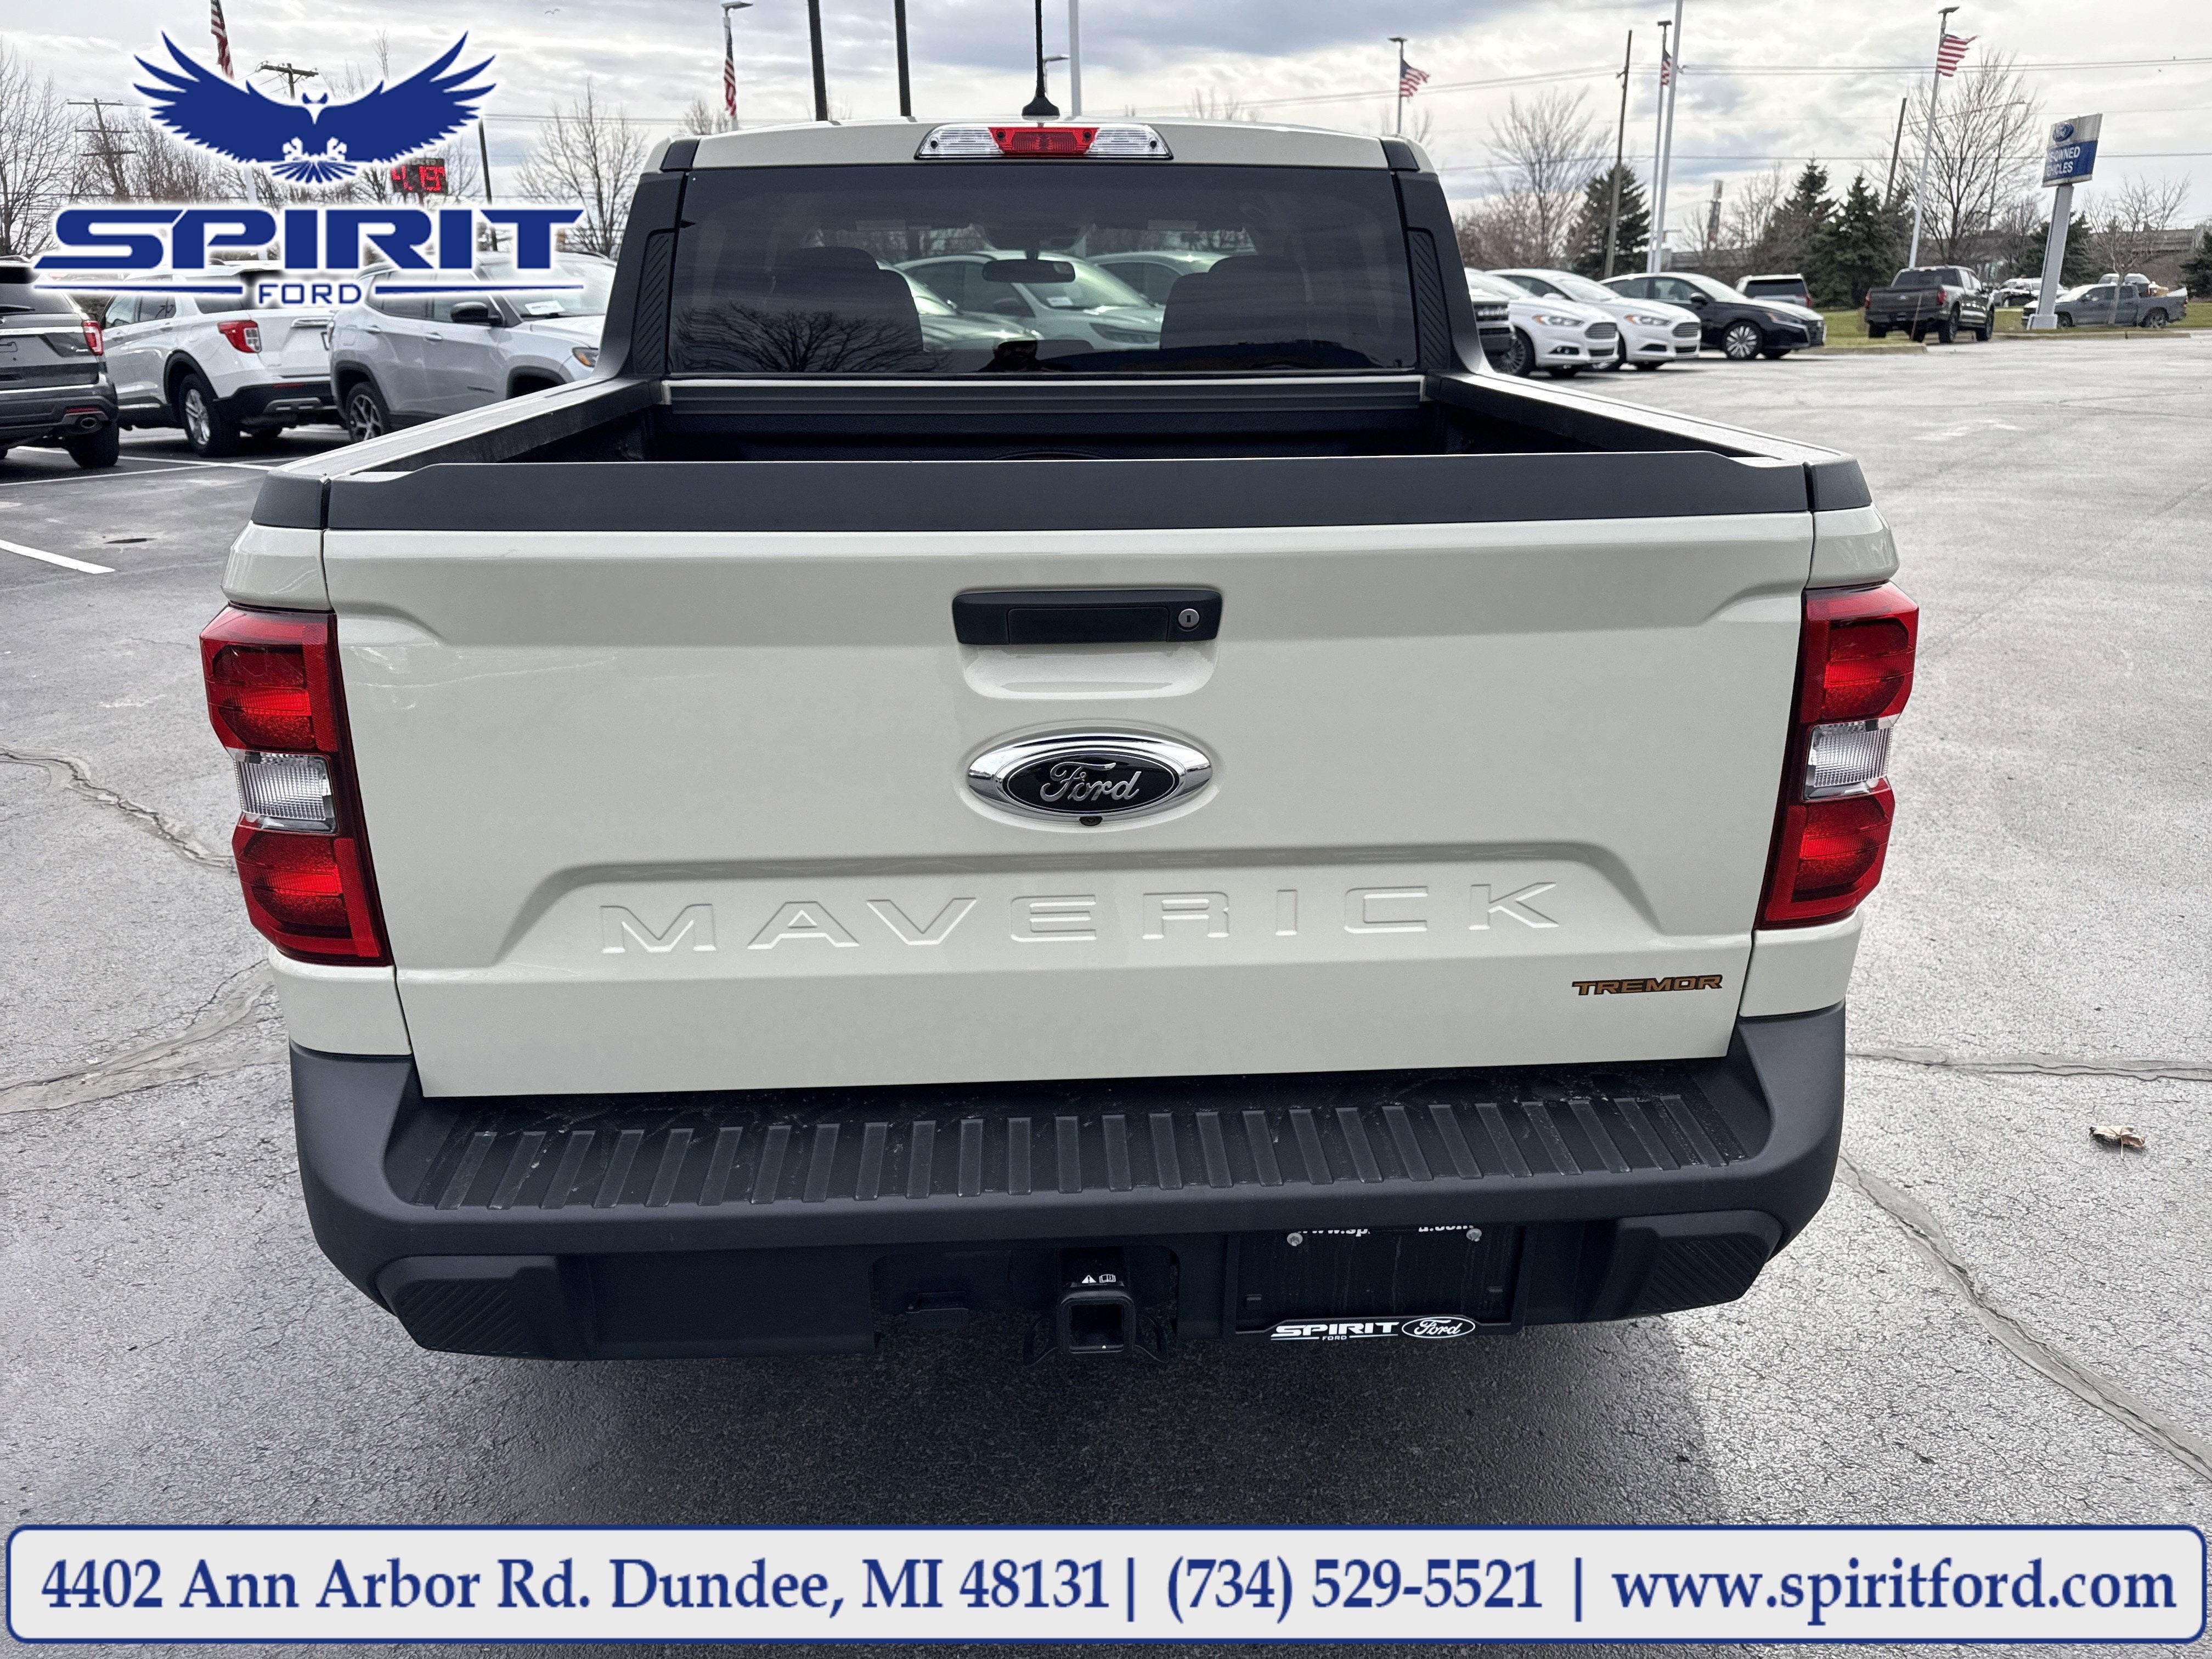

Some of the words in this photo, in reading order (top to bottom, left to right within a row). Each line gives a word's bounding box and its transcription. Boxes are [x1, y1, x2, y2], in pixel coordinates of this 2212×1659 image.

[1040, 761, 1142, 802] Ford
[599, 882, 1560, 954] MAVERICK
[1571, 974, 1723, 996] TREMOR
[1271, 1322, 1400, 1337] SPIRIT
[1413, 1319, 1464, 1335] Ford
